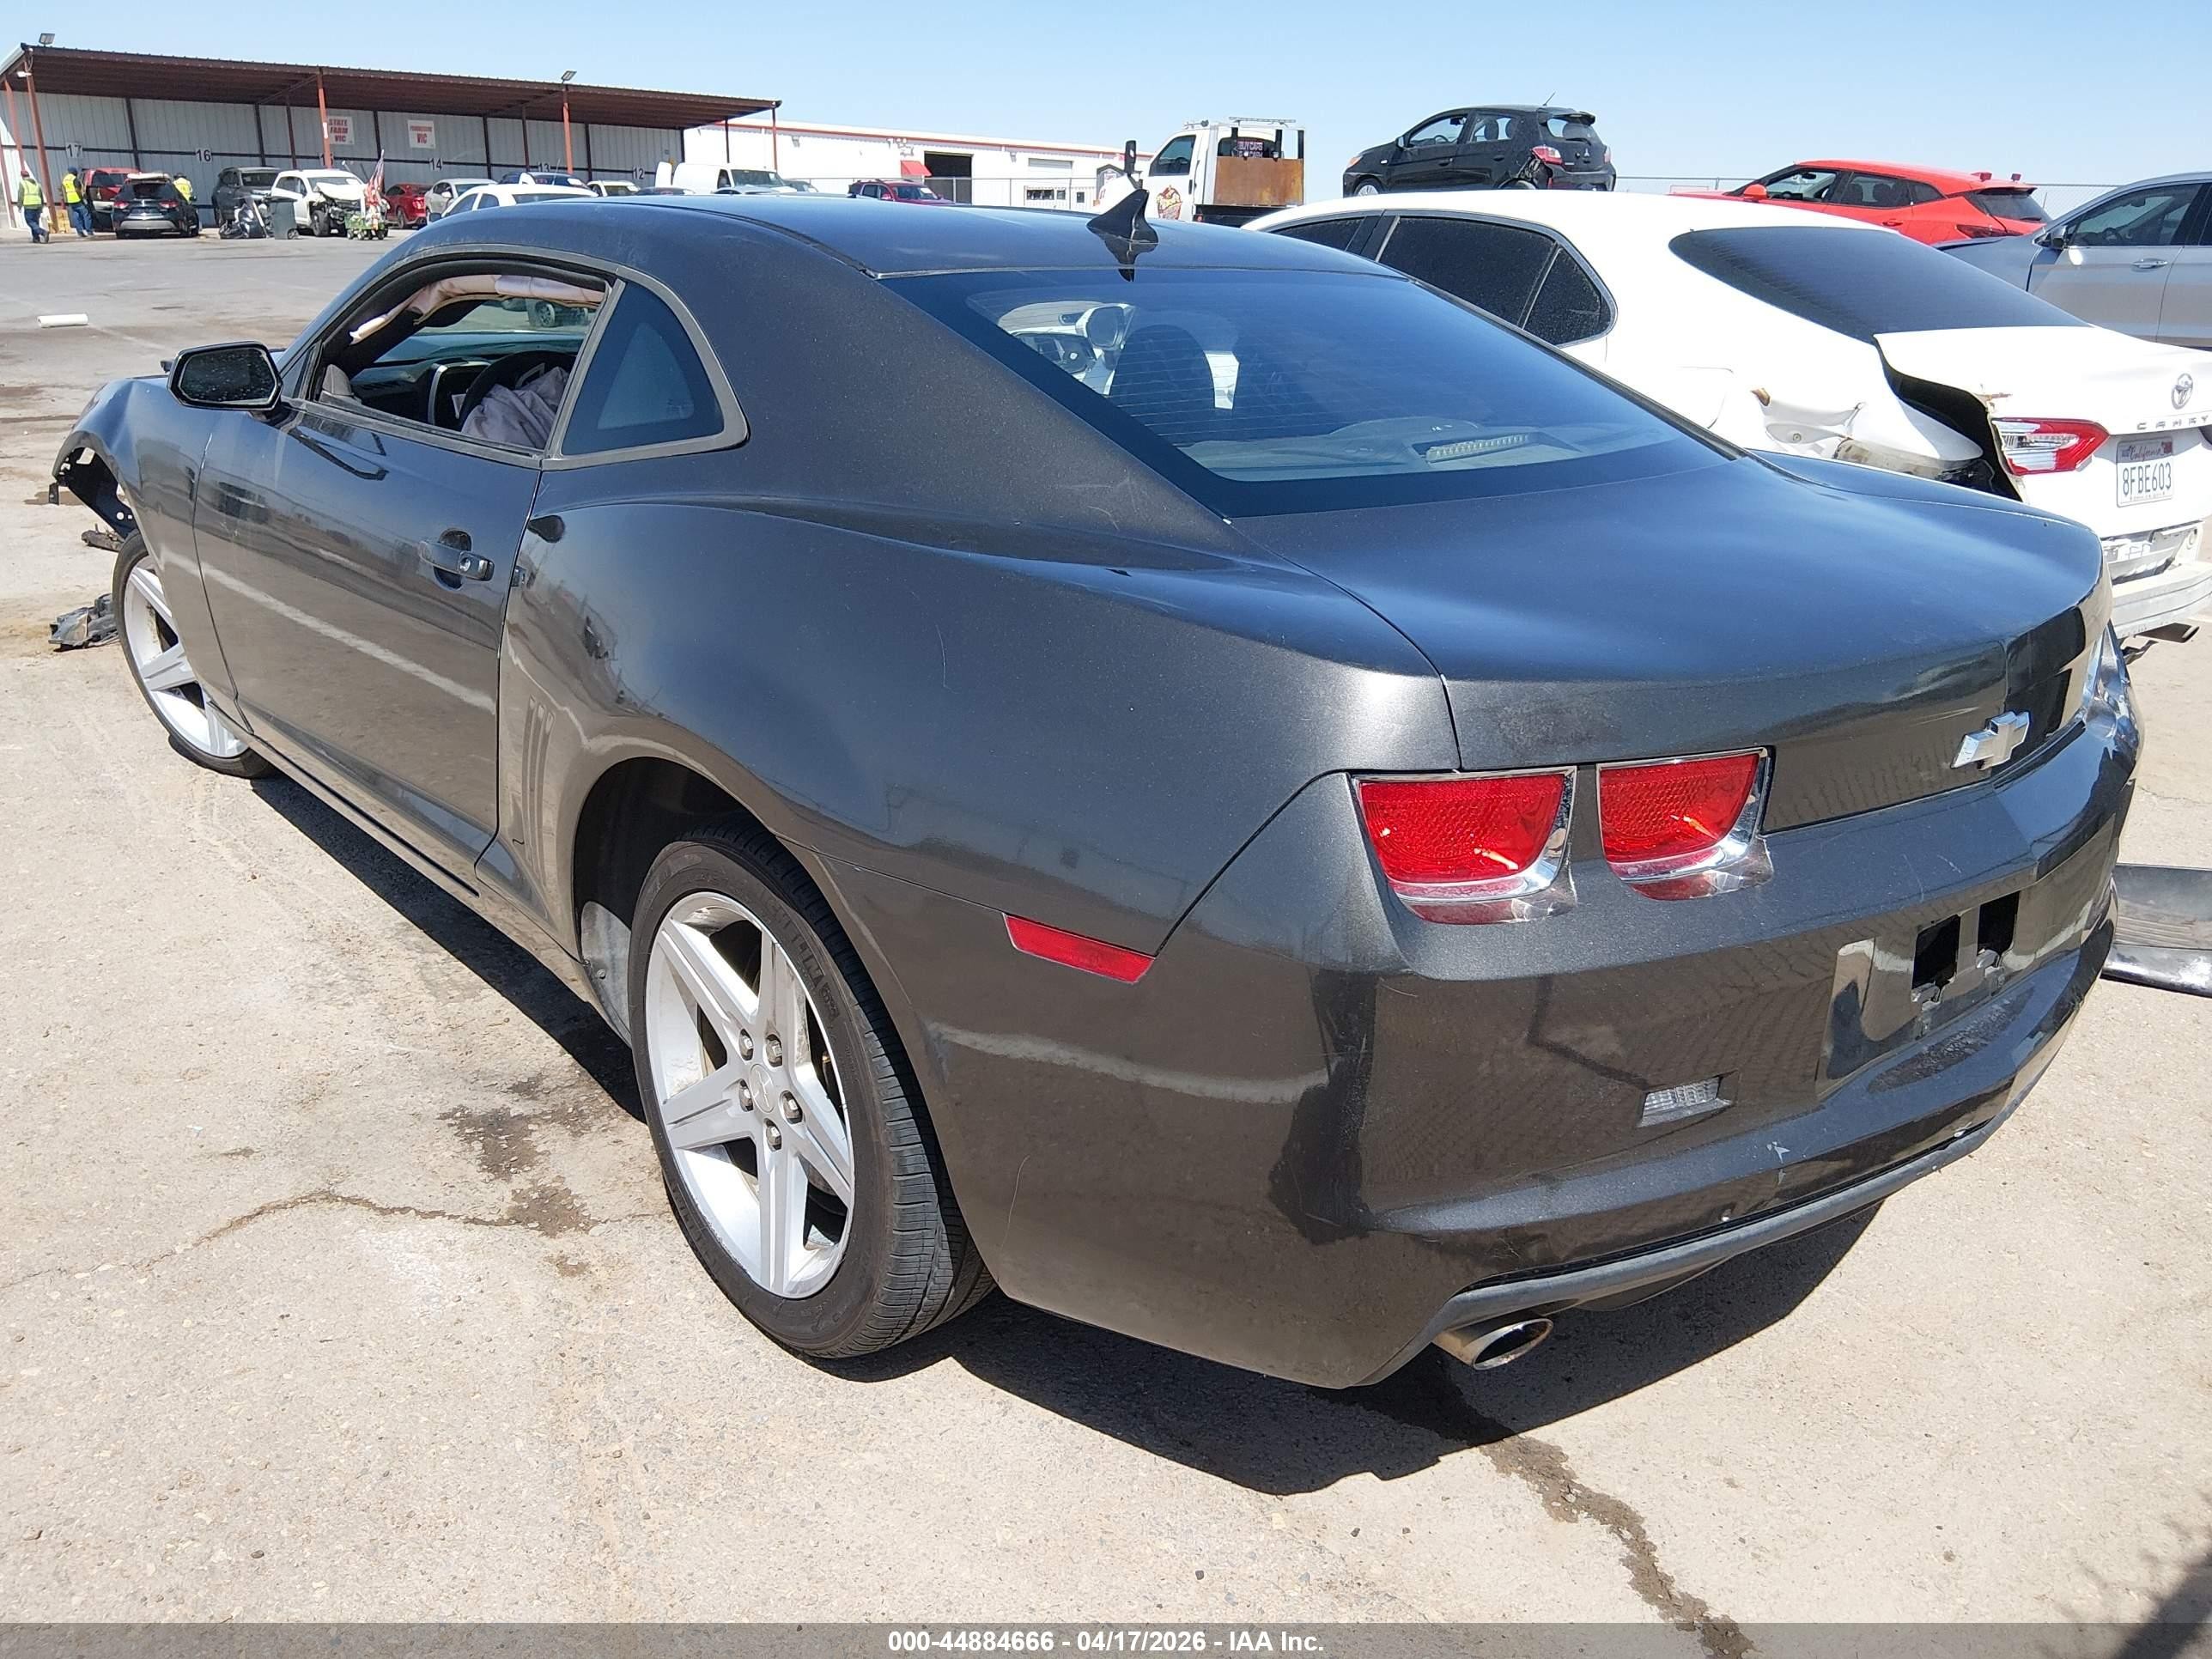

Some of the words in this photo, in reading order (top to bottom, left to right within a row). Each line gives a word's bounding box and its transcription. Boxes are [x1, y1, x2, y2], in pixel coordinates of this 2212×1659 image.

[335, 134, 346, 143] VIC
[417, 133, 428, 144] VIC
[67, 143, 82, 157] 17
[197, 149, 211, 162] 16
[429, 157, 442, 171] 14
[538, 162, 550, 173] 13
[634, 167, 644, 179] 12
[2136, 415, 2209, 430] CAMRY
[2122, 461, 2172, 497] 8FBE603
